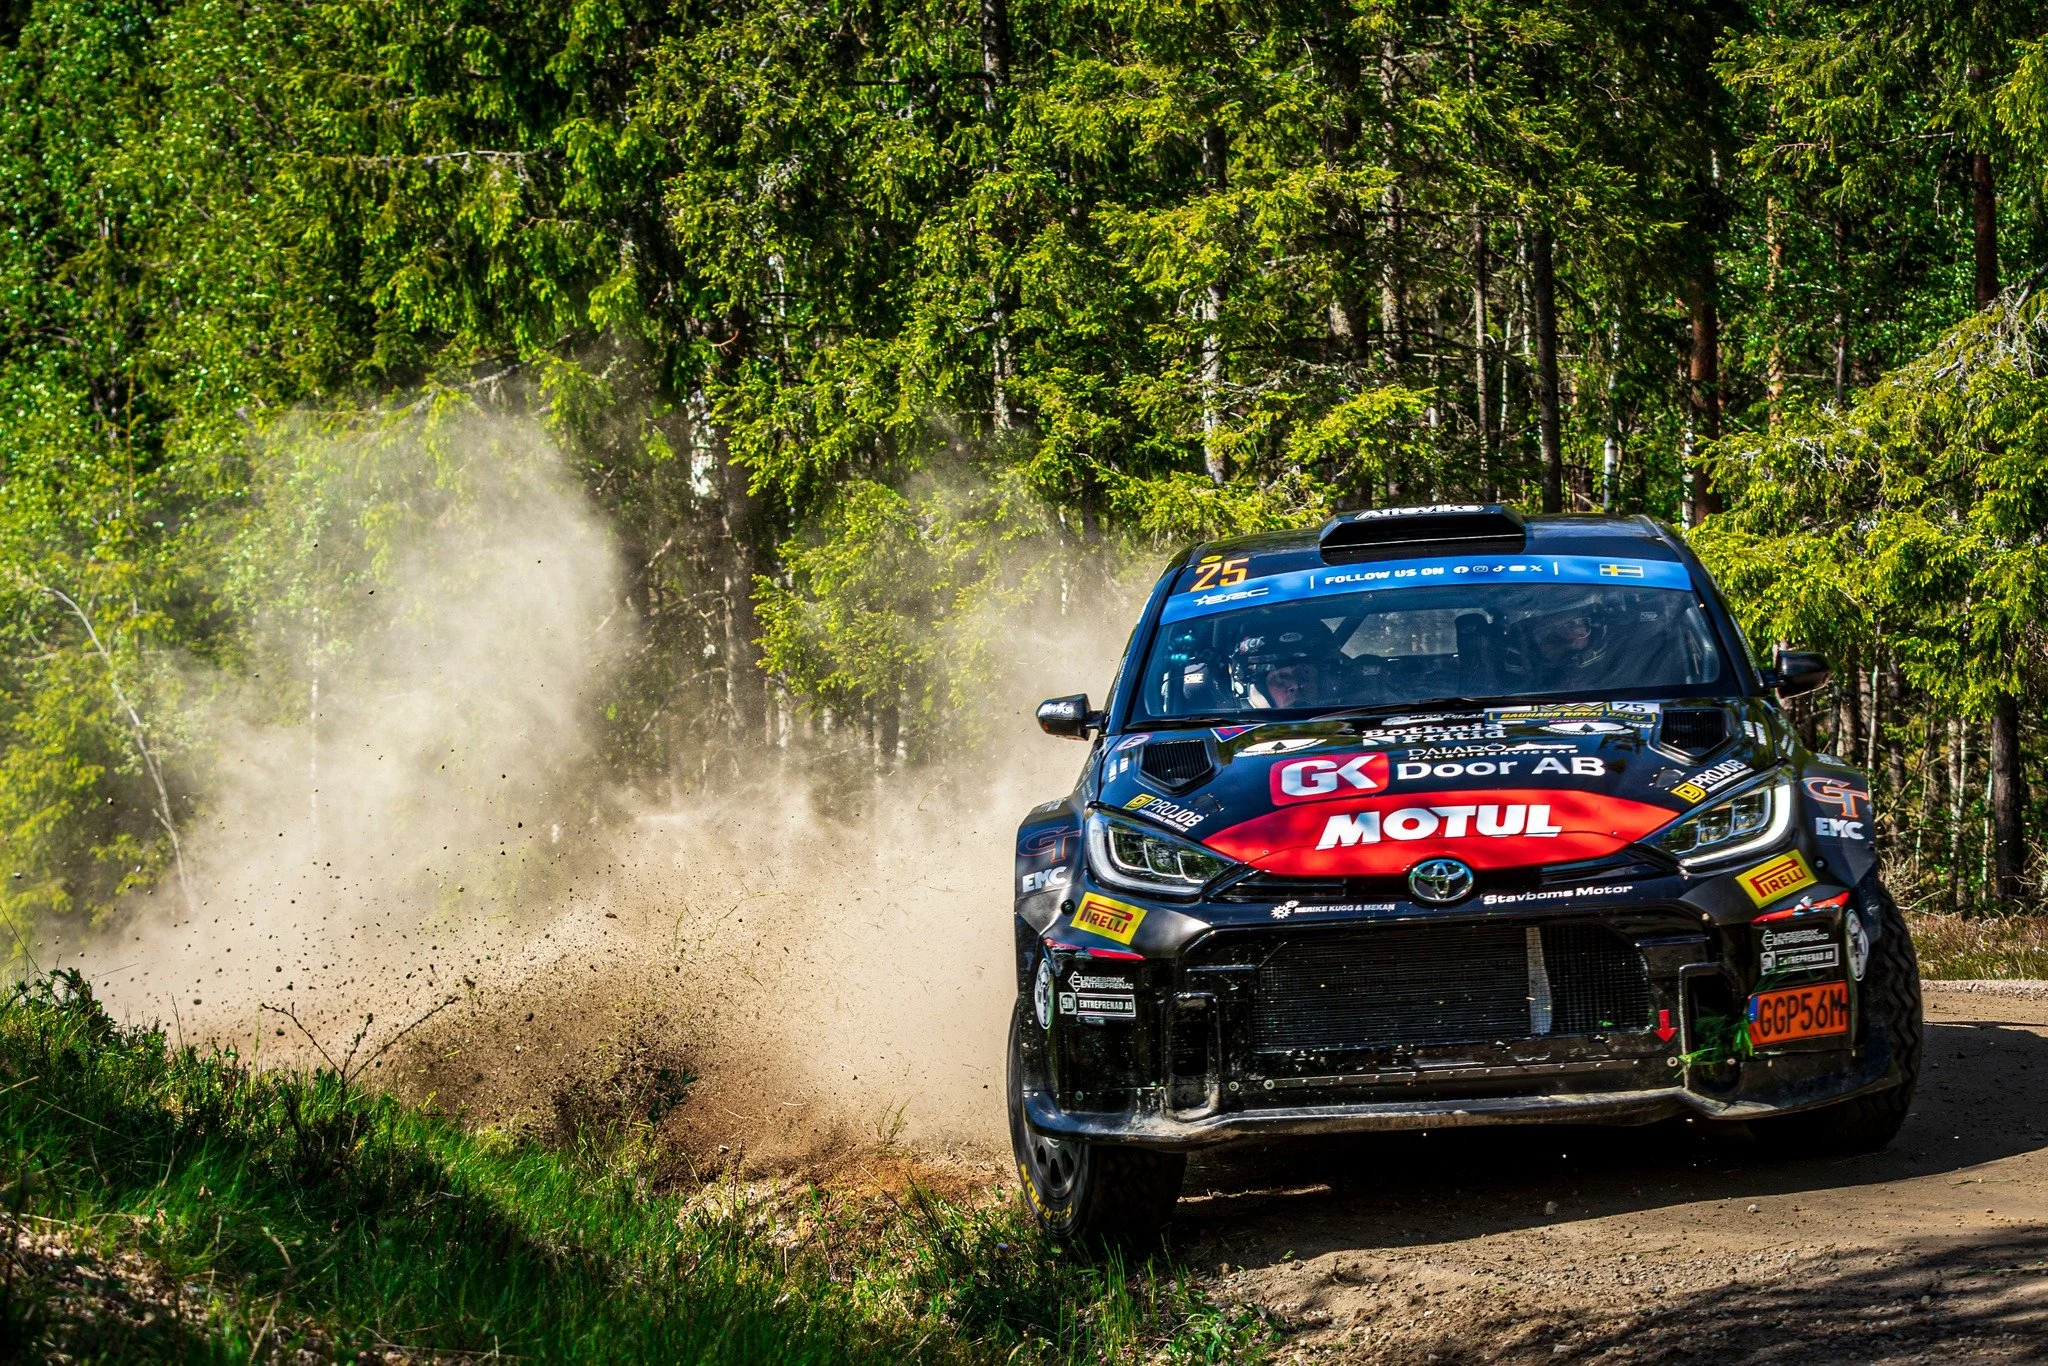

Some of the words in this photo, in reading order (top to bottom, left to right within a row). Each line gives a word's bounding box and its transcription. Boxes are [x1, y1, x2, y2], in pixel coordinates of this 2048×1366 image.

[1189, 557, 1250, 593] 25
[1325, 571, 1391, 585] FOLLOW
[1394, 568, 1417, 578] US
[1420, 566, 1445, 576] ON
[1563, 709, 1604, 718] ROYAL
[1607, 711, 1646, 722] RALLY
[1617, 703, 1646, 713] 25
[1362, 722, 1507, 739] Bothnia
[1402, 729, 1507, 744] Fritid
[1281, 755, 1379, 797] GK
[1397, 760, 1518, 781] Door
[1531, 756, 1606, 777] AB
[1686, 759, 1748, 790] PROJOB
[1143, 798, 1205, 827] PROJOB
[1315, 804, 1563, 851] MOTUL
[1815, 817, 1866, 840] EMC
[1022, 866, 1068, 893] EMC
[1748, 858, 1808, 898] PIRELLI
[1363, 903, 1396, 911] MEKAN
[1482, 888, 1574, 905] Stavboms
[1575, 885, 1634, 897] Motor
[1078, 900, 1135, 934] PIRELLI
[1079, 999, 1124, 1010] ENTREPRENAD
[1124, 1000, 1133, 1010] AB
[1761, 988, 1844, 1037] GGP56M
